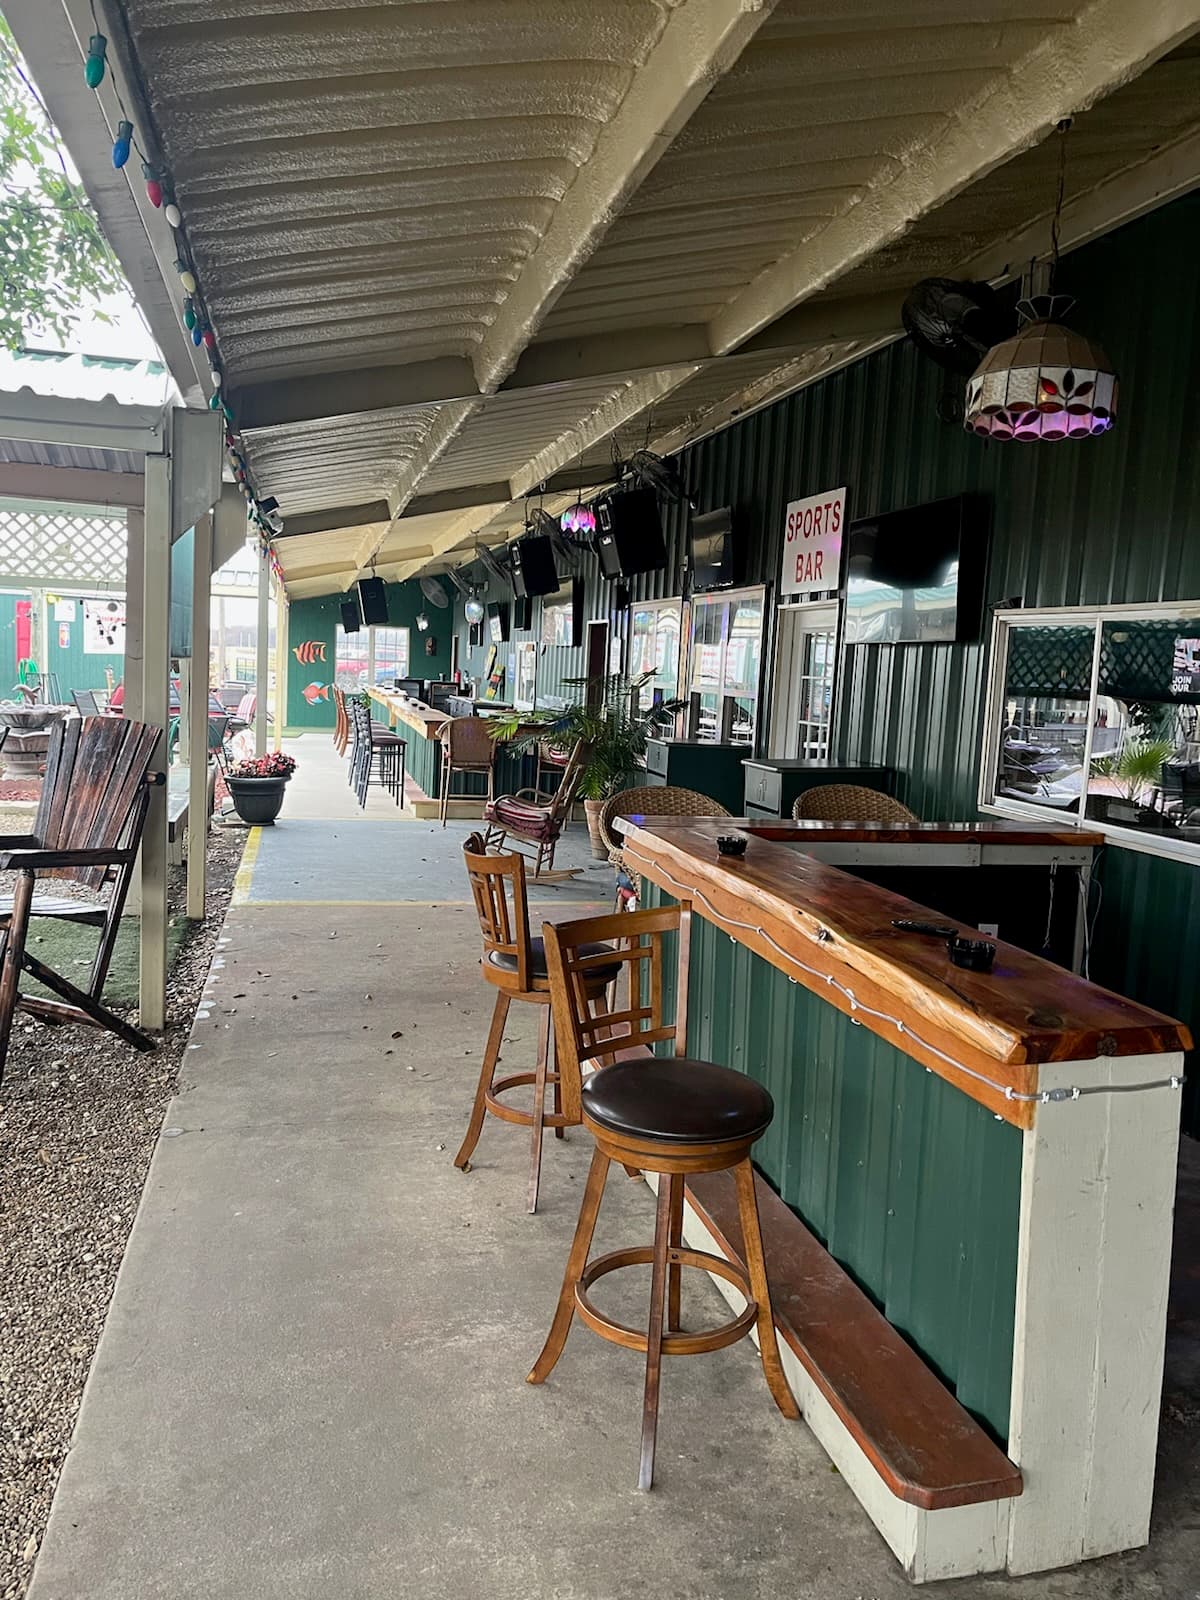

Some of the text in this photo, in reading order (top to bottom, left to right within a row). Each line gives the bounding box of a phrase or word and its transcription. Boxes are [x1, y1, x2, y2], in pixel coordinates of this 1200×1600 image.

[787, 500, 841, 542] SPORTS
[795, 551, 823, 583] BAR
[1172, 676, 1192, 684] JOIN
[1172, 684, 1190, 692] OUR
